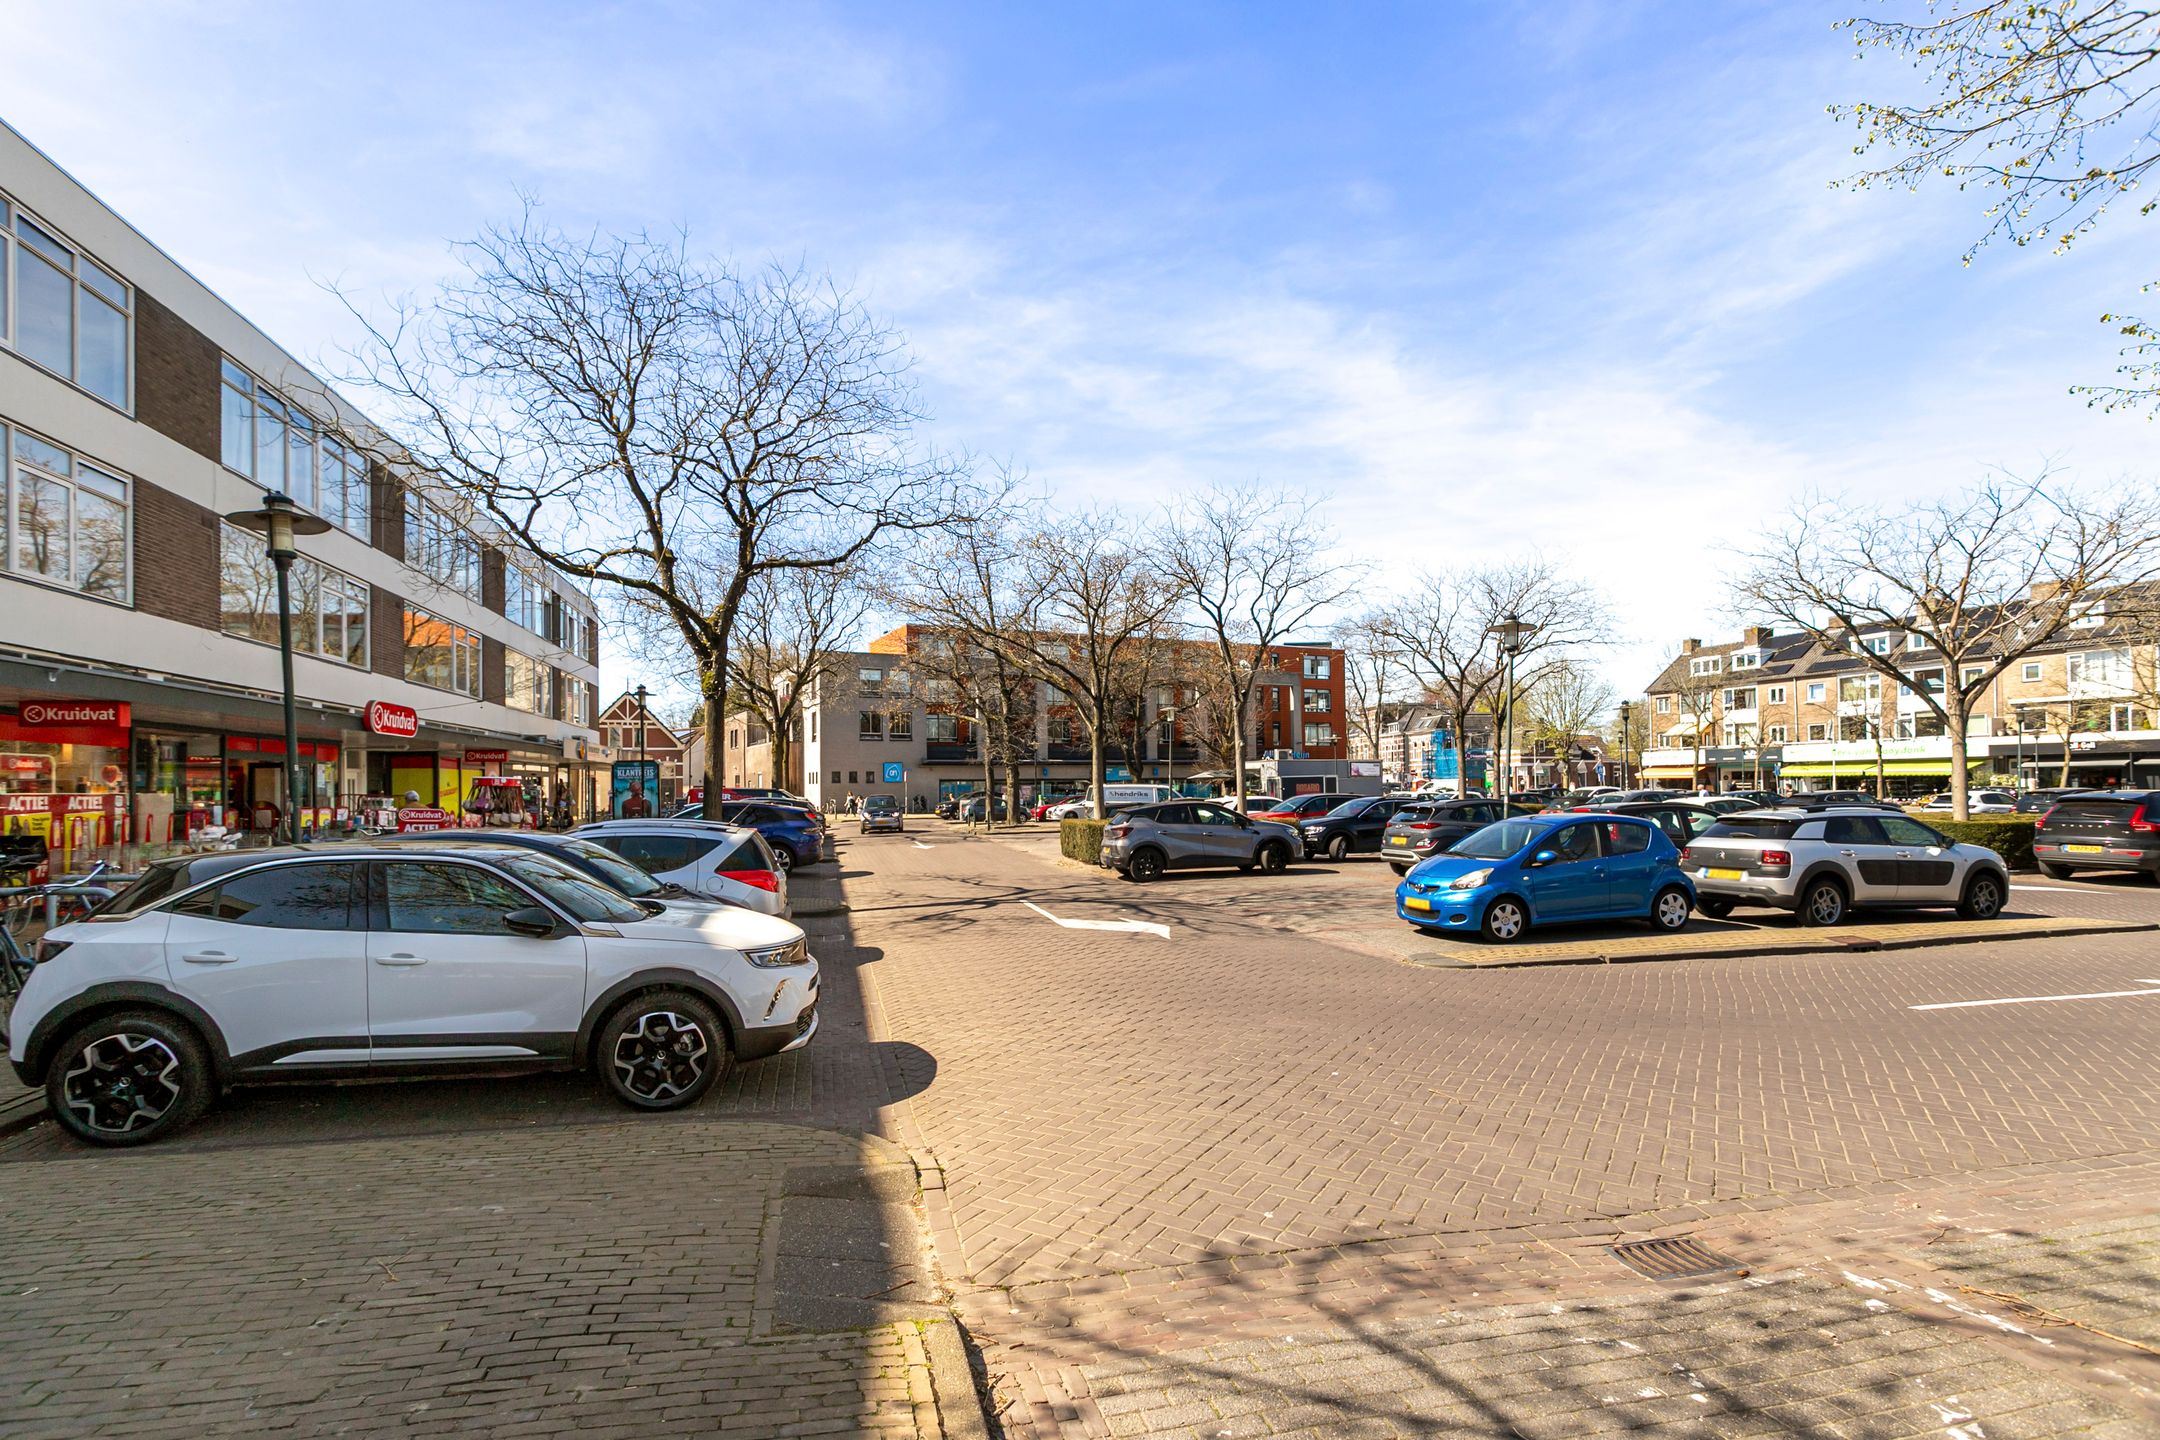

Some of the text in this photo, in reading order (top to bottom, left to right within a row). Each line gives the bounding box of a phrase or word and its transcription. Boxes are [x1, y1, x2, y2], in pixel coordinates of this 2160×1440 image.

[47, 707, 115, 720] Kruidvat
[384, 709, 415, 731] Kruidvat
[475, 752, 505, 760] Kruidvat
[8, 796, 49, 811] ACTIE!
[68, 796, 103, 810] ACTIE!
[411, 811, 442, 819] Kruidvat
